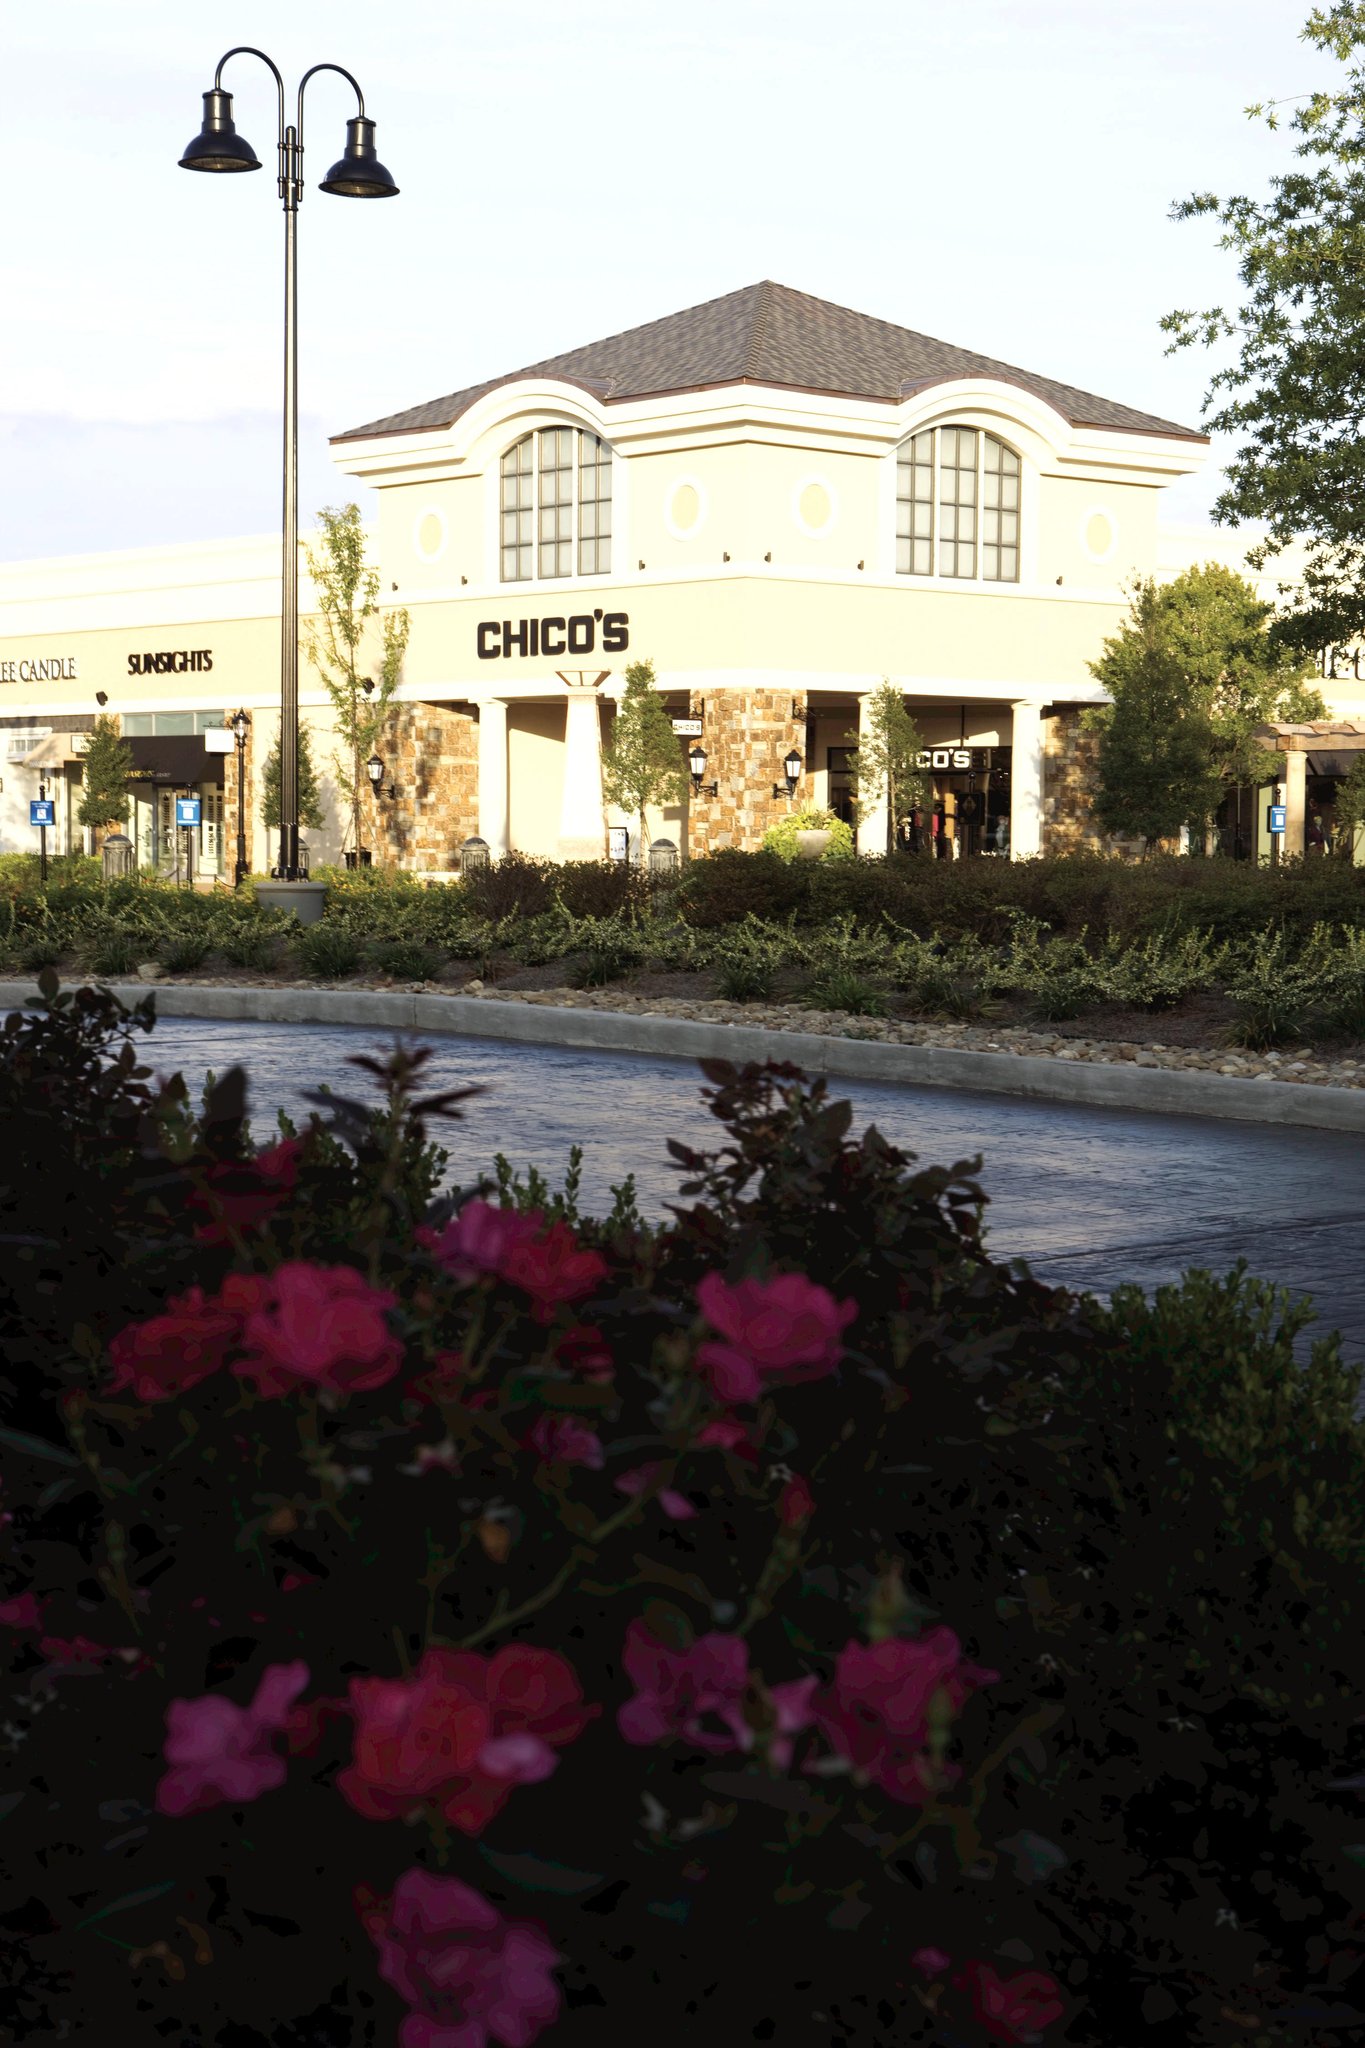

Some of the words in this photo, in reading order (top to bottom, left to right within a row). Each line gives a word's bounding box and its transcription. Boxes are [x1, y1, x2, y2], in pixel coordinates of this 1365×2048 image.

[477, 608, 629, 660] CHICO'S
[0, 661, 17, 683] EE
[19, 657, 77, 682] CANDLE
[127, 649, 213, 676] SUNSIGHTS
[673, 723, 701, 731] CHCOS
[902, 748, 970, 769] CO'S
